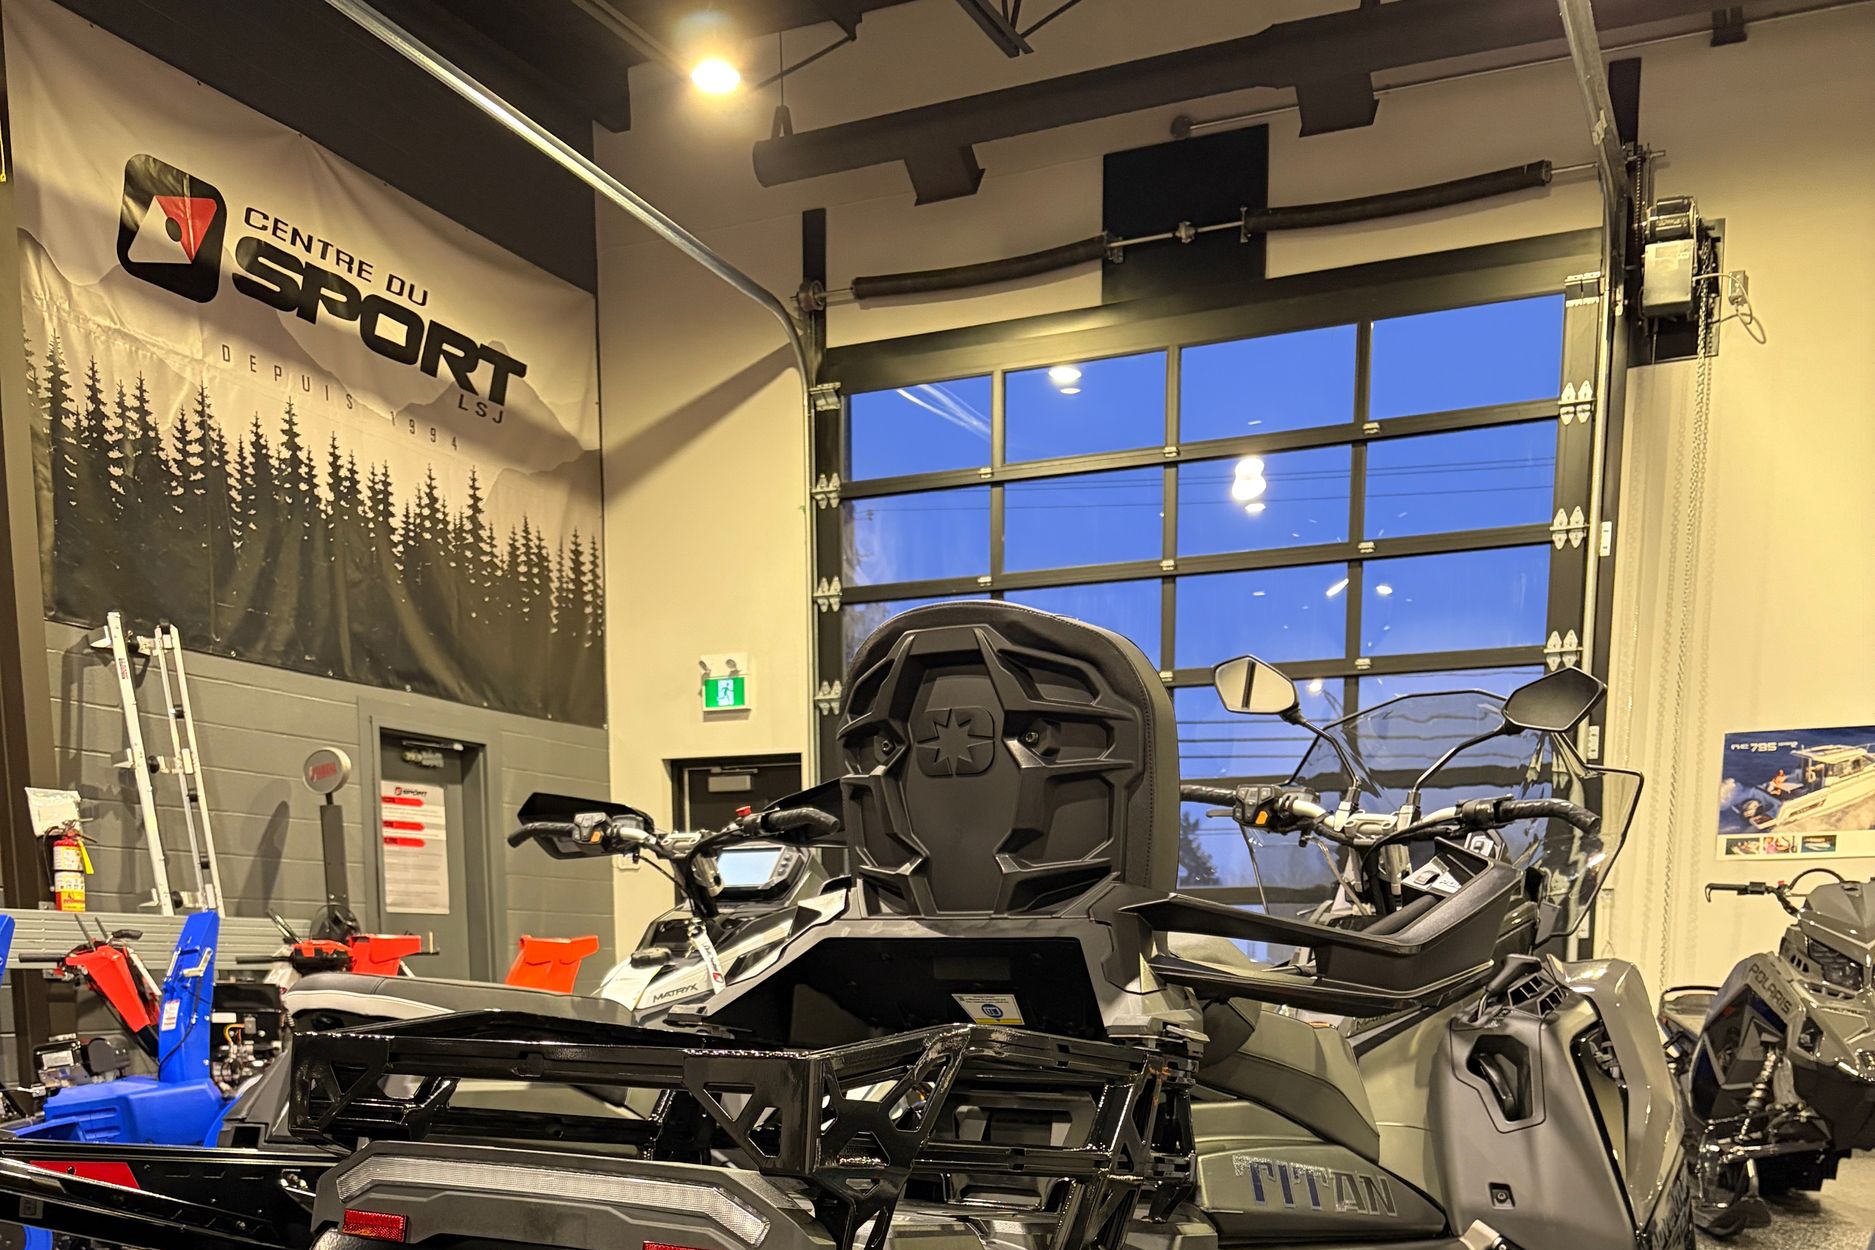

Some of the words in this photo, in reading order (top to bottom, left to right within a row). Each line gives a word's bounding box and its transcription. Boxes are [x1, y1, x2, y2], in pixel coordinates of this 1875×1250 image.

[244, 206, 374, 283] CENTRE
[386, 273, 429, 307] DU
[232, 235, 528, 407] SPORT
[221, 343, 354, 410] DEPUIS
[390, 410, 458, 451] 1994
[458, 393, 504, 424] LSJ
[652, 983, 699, 1003] MATRYX
[1748, 962, 1793, 1015] POLARIS
[1232, 1154, 1398, 1217] TITAN
